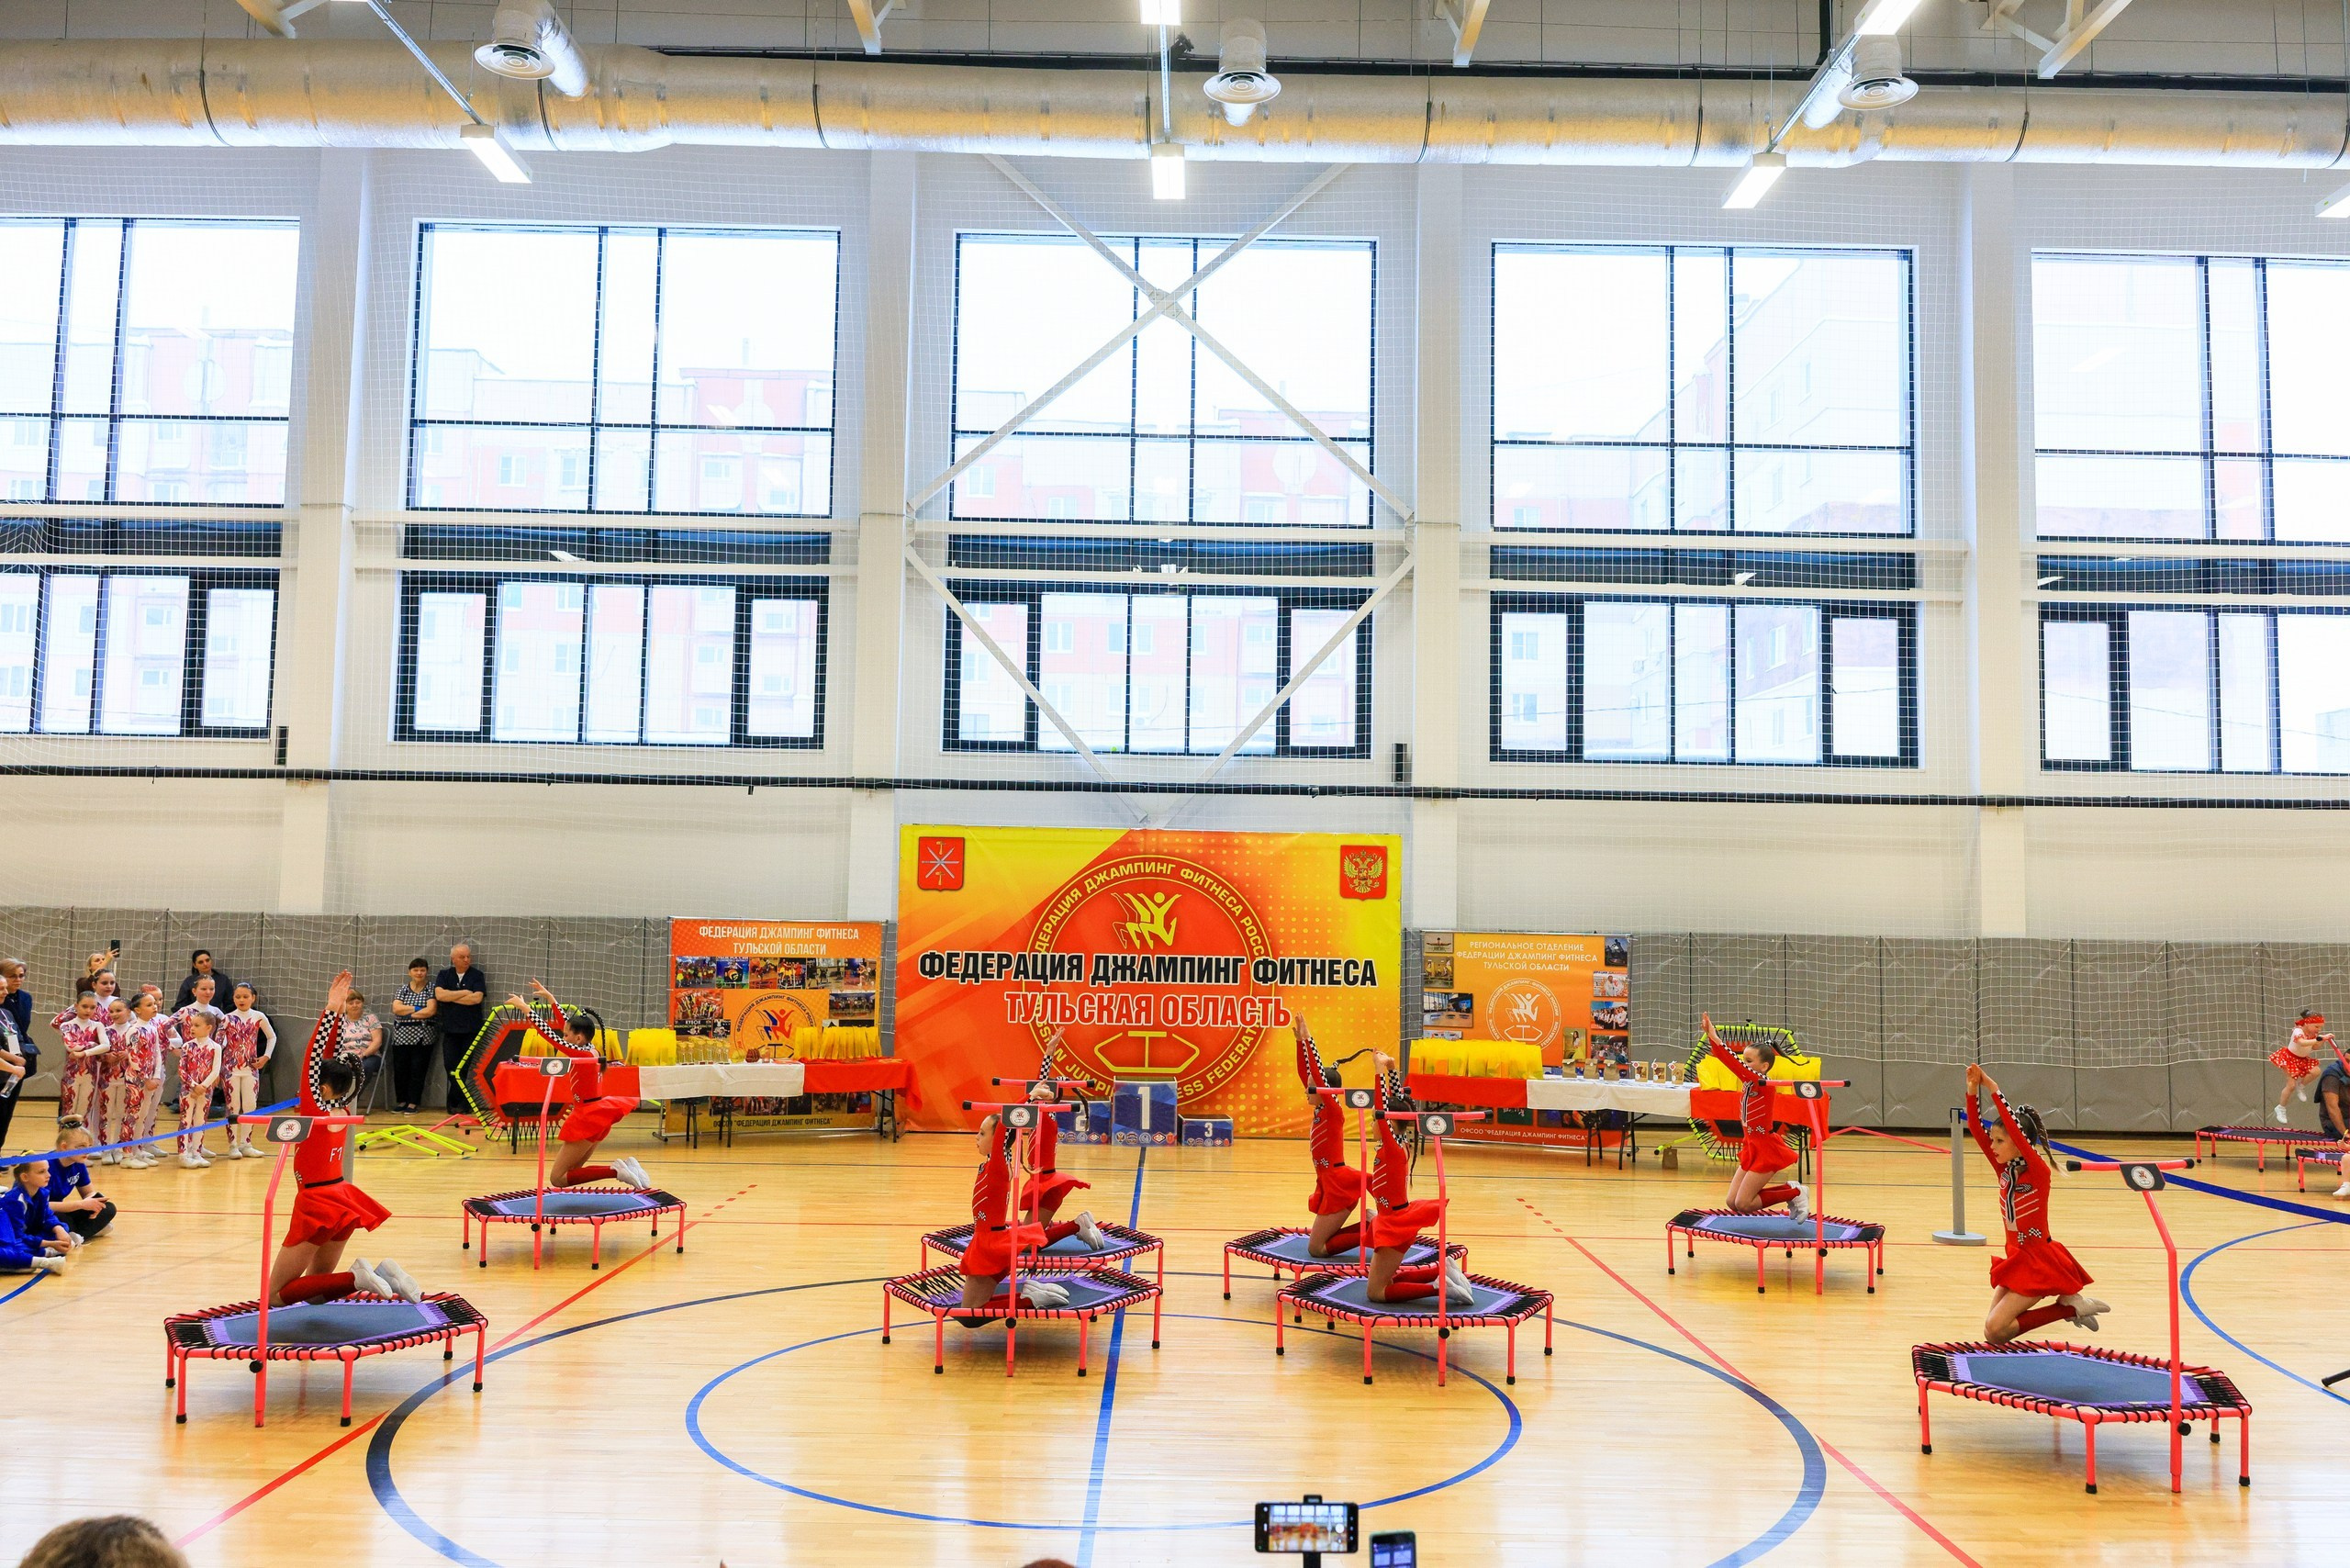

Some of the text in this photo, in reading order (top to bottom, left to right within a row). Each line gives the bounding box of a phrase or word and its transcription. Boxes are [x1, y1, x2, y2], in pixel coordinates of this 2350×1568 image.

[1034, 861, 1266, 958] ДЕРАЦИЯ ДЖАМПИНГ ФИТНЕСА РОСС
[699, 925, 859, 940] ФЕДЕРАЦИЯ ДЖАМПИНГ ФИТНЕСА
[733, 942, 826, 956] ТУЛЬСКОЙ ОБЛАСТИ
[1470, 941, 1584, 952] РЕГИОНАЛЬНОЕ ОТДЕЛЕНИЕ
[1456, 951, 1598, 962] ФЕДЕРАЦИИ ДЖАМПИНГ ФИТНЕСА
[919, 950, 1378, 988] ФЕДЕРАЦИЯ ДЖАМПИНГ ФИТНЕСА
[1483, 960, 1570, 971] ТУЛЬСКОЙ ОБЛАСТИ
[755, 994, 785, 1005] ДЖАМПИНГ
[787, 996, 807, 1012] ФИТНЕСА
[1004, 992, 1292, 1028] ТУЛЬСКАЯ ОБЛАСТЬ
[1206, 1025, 1258, 1084] FEDERAT
[1137, 1086, 1151, 1130] 1
[1075, 1104, 1090, 1132] 2
[1204, 1122, 1214, 1137] 3
[1522, 1131, 1557, 1139] ДЖАМПИНГ
[329, 1146, 343, 1163] F1
